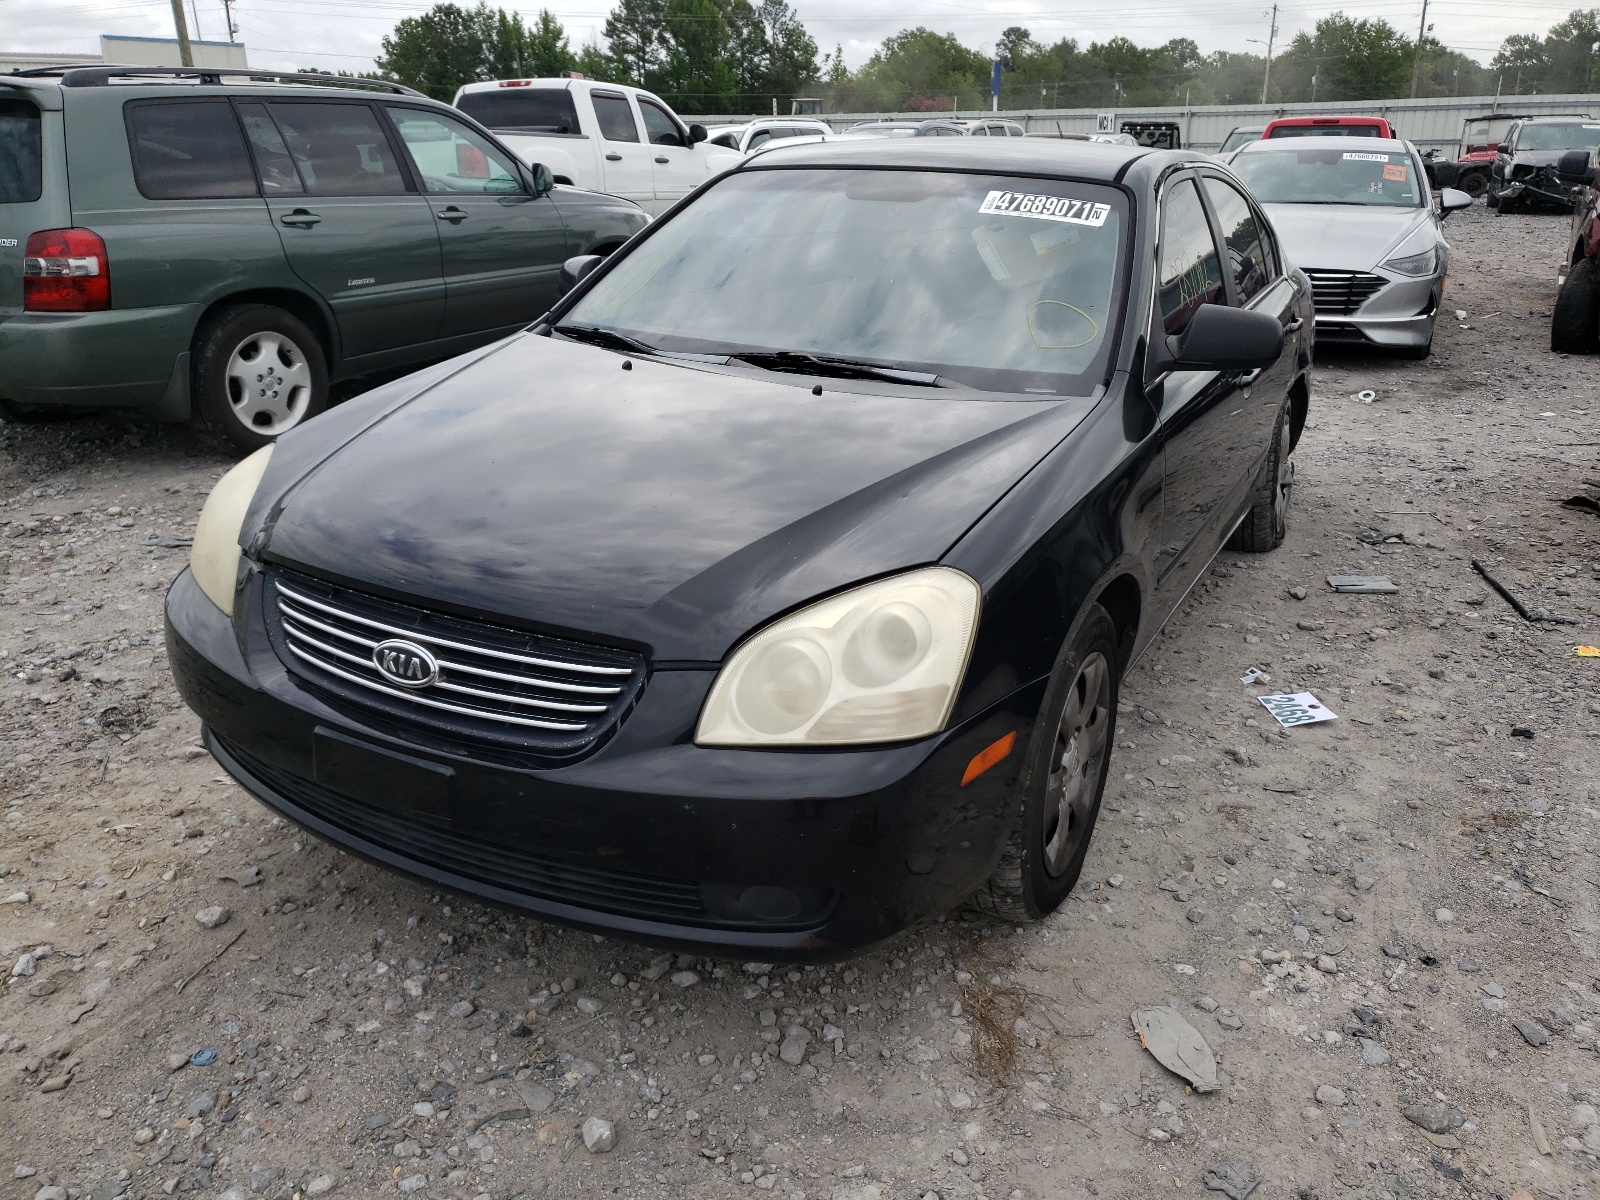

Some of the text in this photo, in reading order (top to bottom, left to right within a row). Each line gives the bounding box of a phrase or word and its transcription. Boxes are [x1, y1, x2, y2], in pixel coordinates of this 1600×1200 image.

[997, 192, 1091, 220] 47689071
[0, 238, 18, 247] DER
[383, 649, 423, 680] KIA
[1261, 696, 1316, 724] 2468
